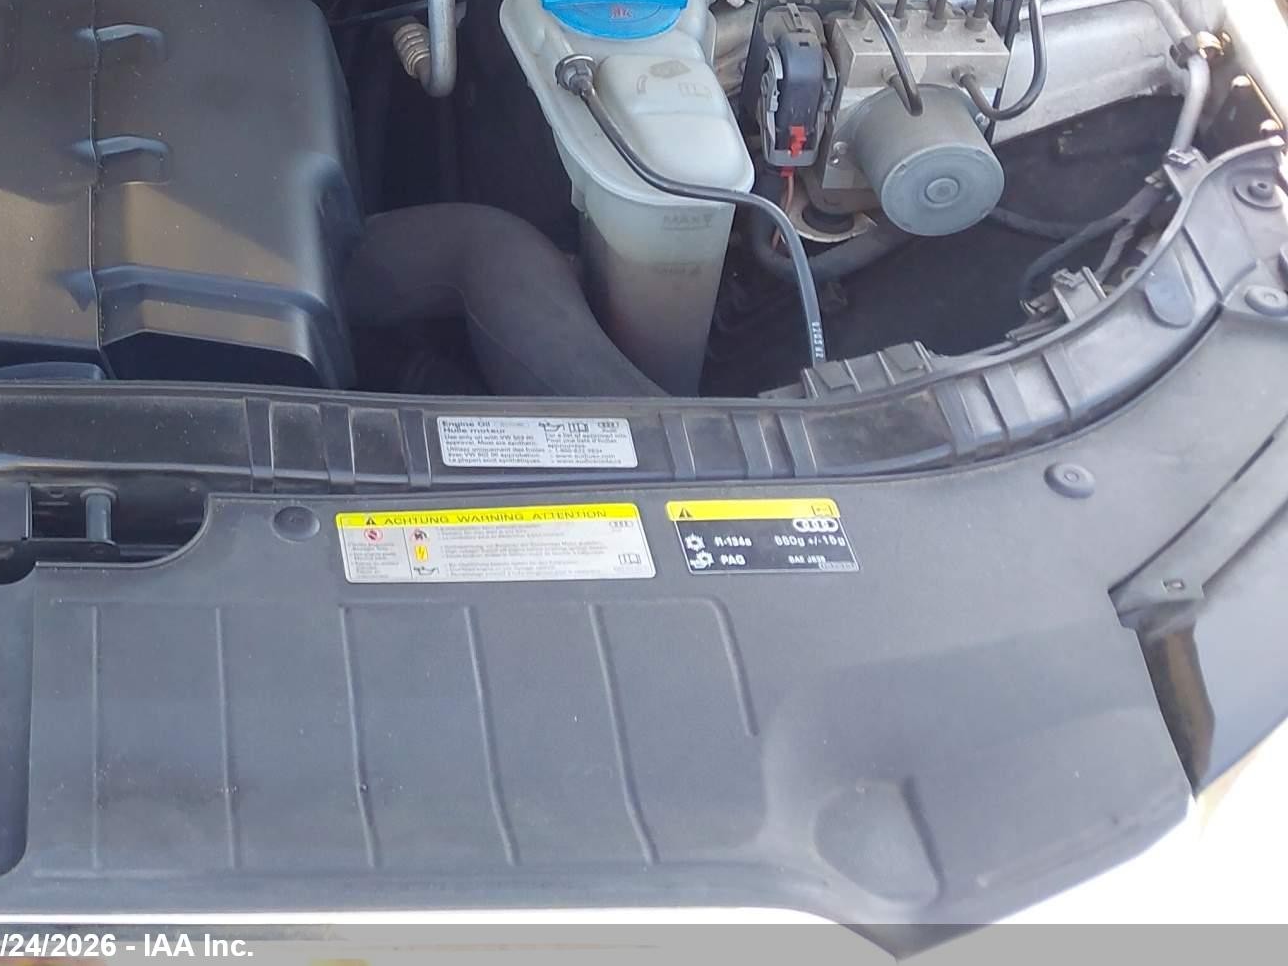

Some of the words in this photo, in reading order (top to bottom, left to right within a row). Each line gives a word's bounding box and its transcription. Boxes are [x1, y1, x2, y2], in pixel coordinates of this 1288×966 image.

[384, 516, 449, 525] ACHTUNG
[456, 514, 524, 523] WARNING
[532, 511, 607, 520] ATTENTION
